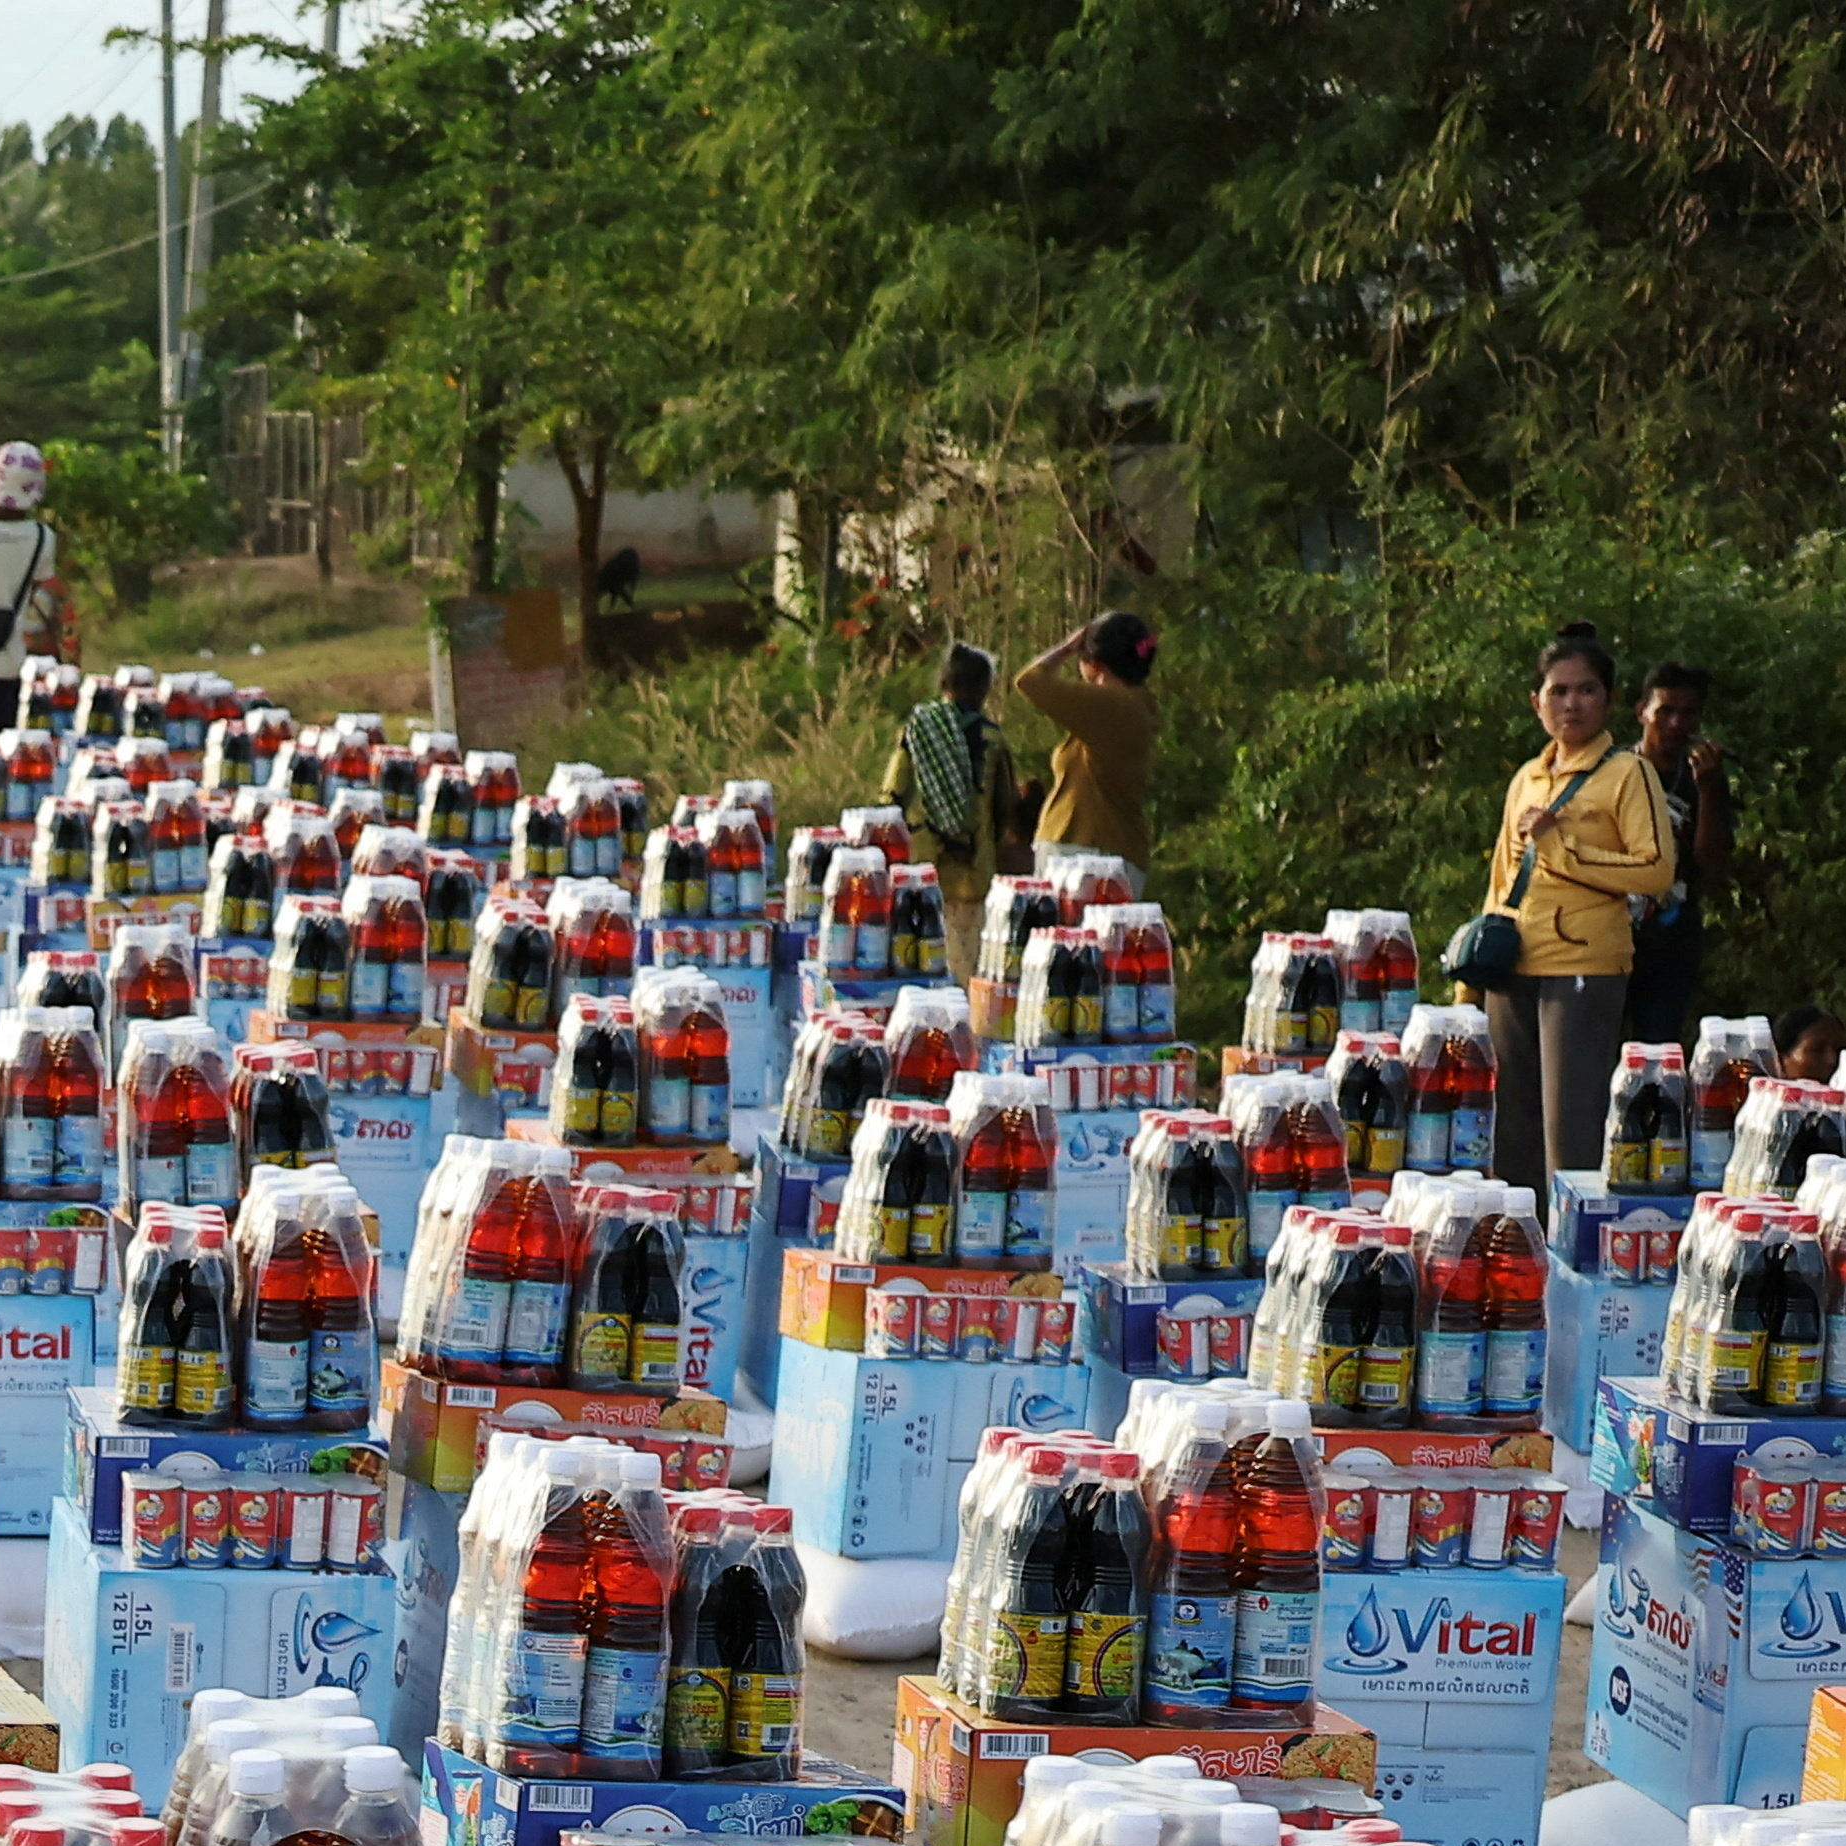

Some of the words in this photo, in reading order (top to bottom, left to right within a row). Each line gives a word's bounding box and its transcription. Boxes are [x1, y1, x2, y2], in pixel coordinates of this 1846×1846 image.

[683, 1297, 723, 1391] Vital
[112, 1592, 128, 1612] 12
[112, 1619, 129, 1656] BTL
[133, 1603, 152, 1647] 1.5L
[1391, 1597, 1535, 1656] Vital
[1435, 1655, 1491, 1668] Premium
[1496, 1657, 1532, 1670] Water
